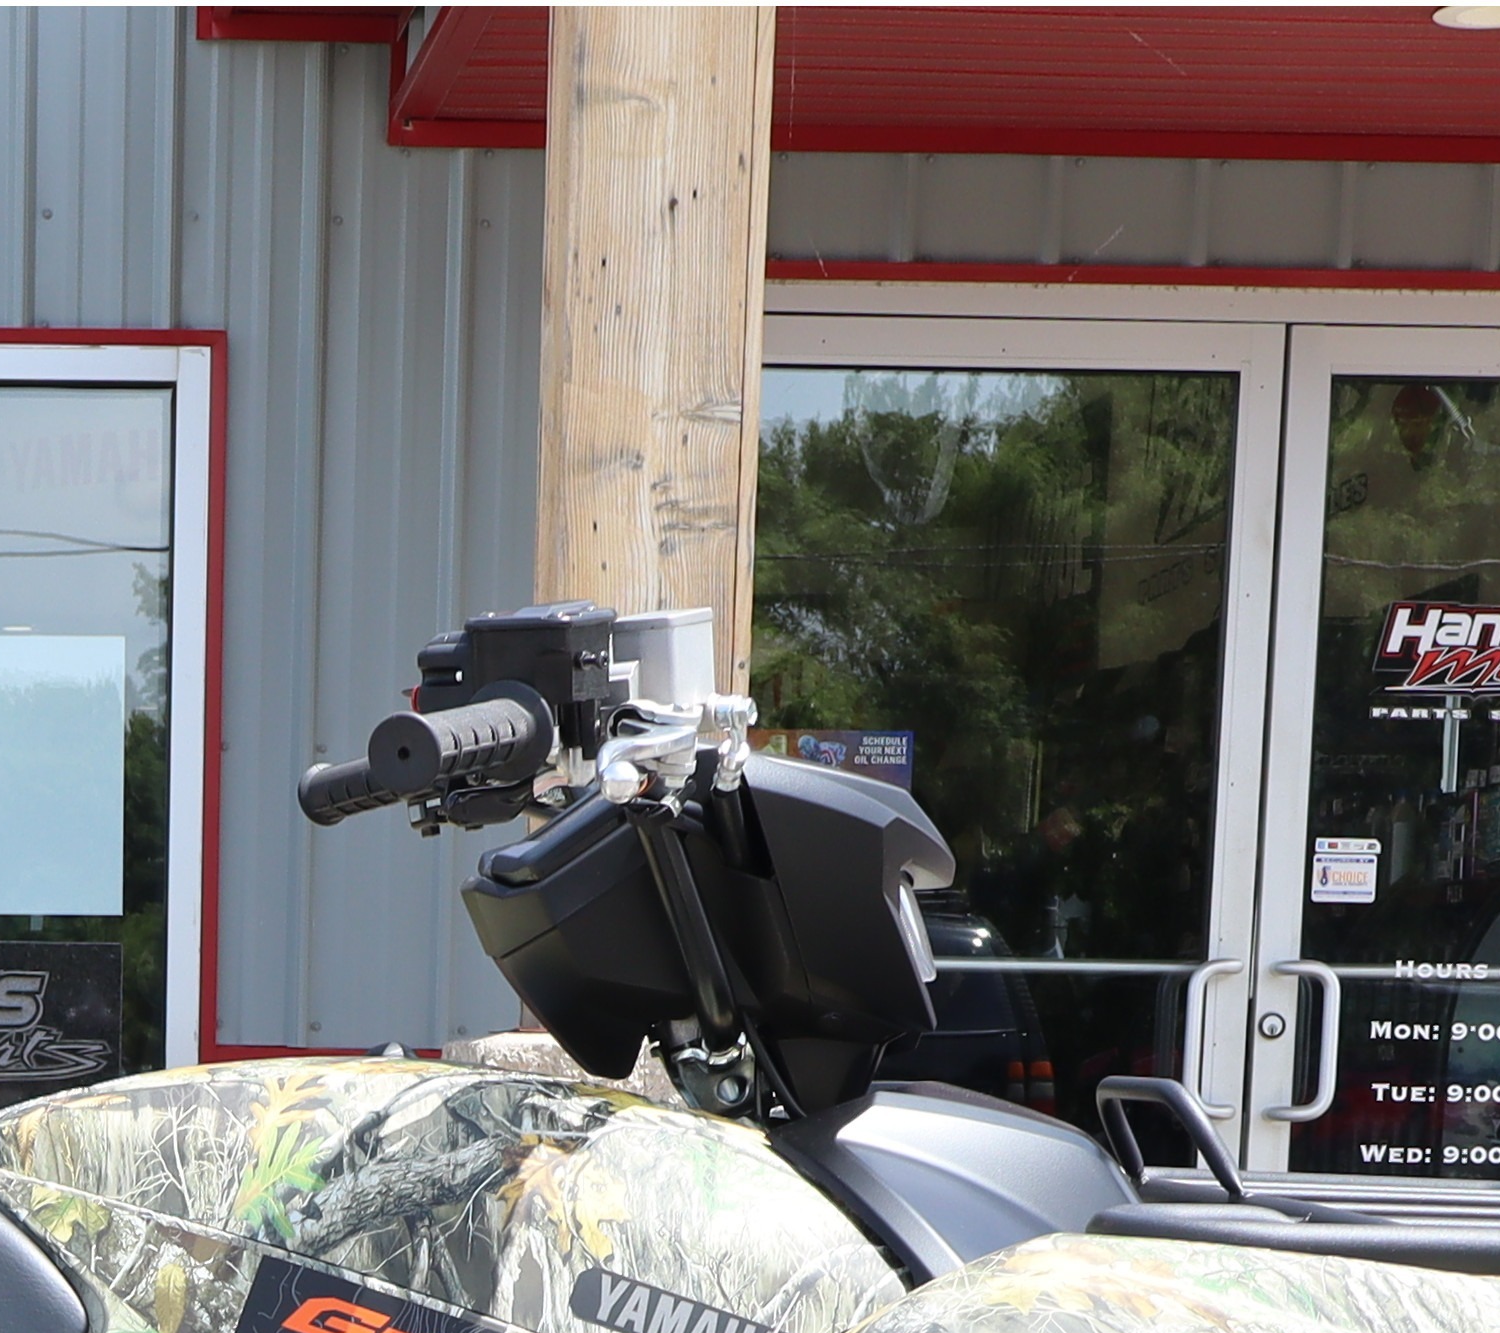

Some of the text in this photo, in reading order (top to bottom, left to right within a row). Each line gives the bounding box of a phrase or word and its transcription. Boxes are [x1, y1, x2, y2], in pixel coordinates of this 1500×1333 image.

[1370, 706, 1471, 720] PARTS
[862, 736, 909, 746] SCHEDULE
[858, 746, 908, 755] YOUR NEXT
[854, 755, 907, 765] OIL CHANGE
[1331, 871, 1369, 883] CHOICE
